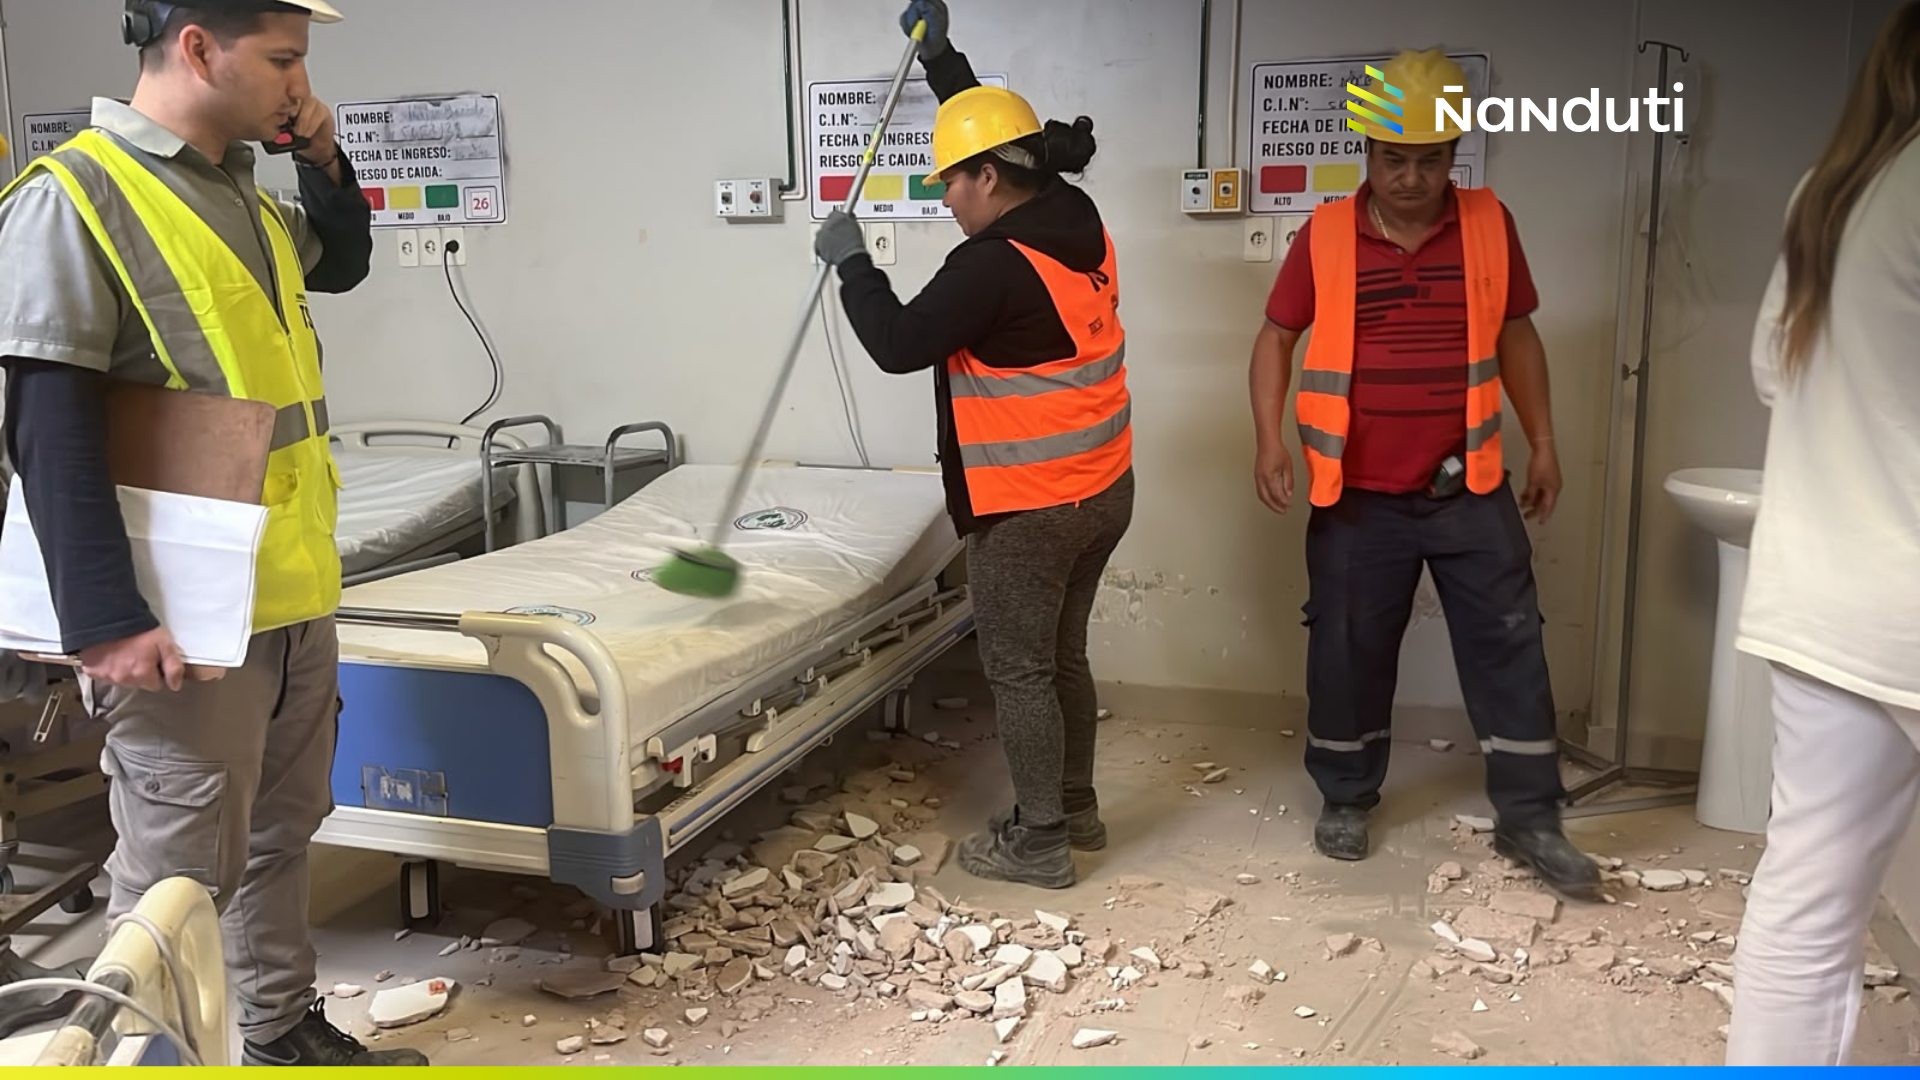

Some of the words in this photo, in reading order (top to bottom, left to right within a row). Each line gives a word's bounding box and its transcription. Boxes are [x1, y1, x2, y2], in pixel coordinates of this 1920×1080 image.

[1264, 73, 1333, 90] NOMBRE:
[818, 91, 877, 106] NOMBRE:
[345, 111, 394, 125] NOMBRE:
[1262, 120, 1309, 135] FECHA
[1315, 119, 1334, 133] DE
[819, 134, 859, 147] FECHA
[884, 132, 934, 146] INGRES
[349, 150, 382, 162] FECHA
[386, 149, 398, 160] DE
[402, 146, 451, 159] INGRESO:
[1262, 142, 1314, 157] RIESGO
[1320, 141, 1339, 156] DE
[1344, 140, 1367, 155] CAI
[819, 154, 865, 168] RIESGO
[889, 153, 931, 166] CAIDA:
[391, 168, 404, 179] DE
[408, 166, 443, 178] CAIDA:
[473, 198, 490, 210] 26
[1274, 197, 1292, 206] ALTO
[398, 212, 415, 220] MEDIO
[438, 214, 451, 222] BAJO
[874, 204, 894, 213] MEDIO
[922, 206, 938, 215] BAJO
